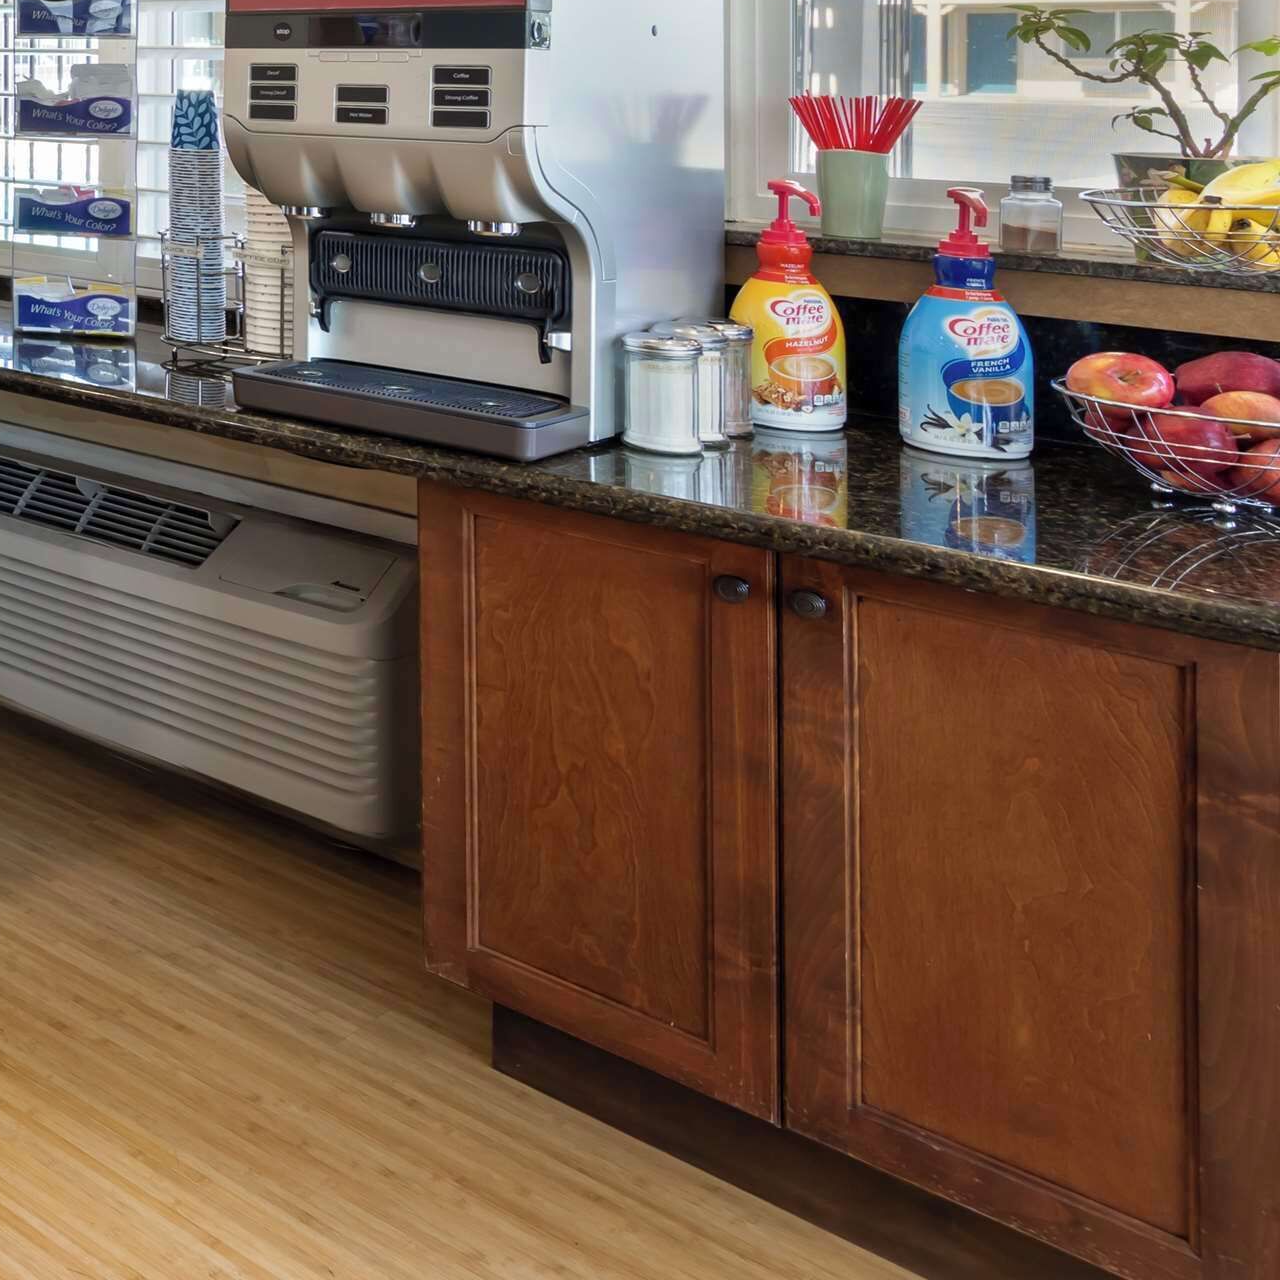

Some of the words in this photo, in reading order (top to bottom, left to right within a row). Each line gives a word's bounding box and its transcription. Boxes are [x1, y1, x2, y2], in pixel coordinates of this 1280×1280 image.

[32, 108, 63, 121] What's
[65, 113, 83, 126] Your
[86, 119, 117, 131] Color?
[32, 206, 62, 220] What's
[65, 213, 84, 225] Your
[85, 219, 116, 231] Color?
[31, 303, 62, 317] What's
[64, 311, 83, 323] Your
[85, 317, 115, 329] Color?
[770, 300, 823, 317] Coffee
[948, 318, 1009, 337] Coffee
[785, 336, 828, 348] HAZELNUT
[966, 334, 1009, 346] mate
[971, 358, 1010, 368] FRENCH
[971, 364, 1011, 373] VANILLA
